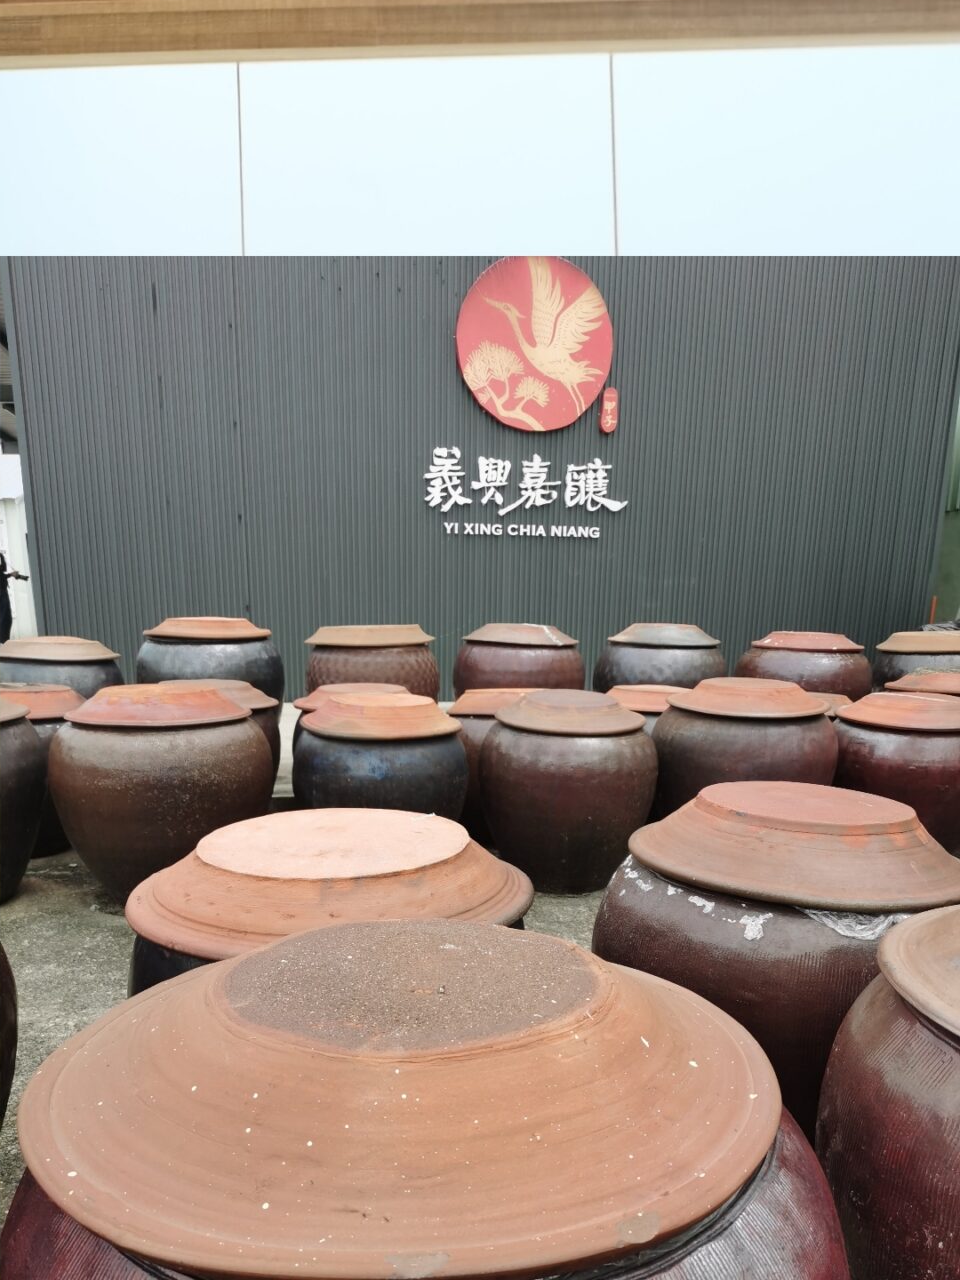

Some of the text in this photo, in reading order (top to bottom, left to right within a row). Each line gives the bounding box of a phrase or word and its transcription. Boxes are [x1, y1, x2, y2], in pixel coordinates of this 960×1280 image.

[423, 446, 629, 516] 義興嘉釀
[444, 522, 601, 539] YI XING CHIA NIANG
